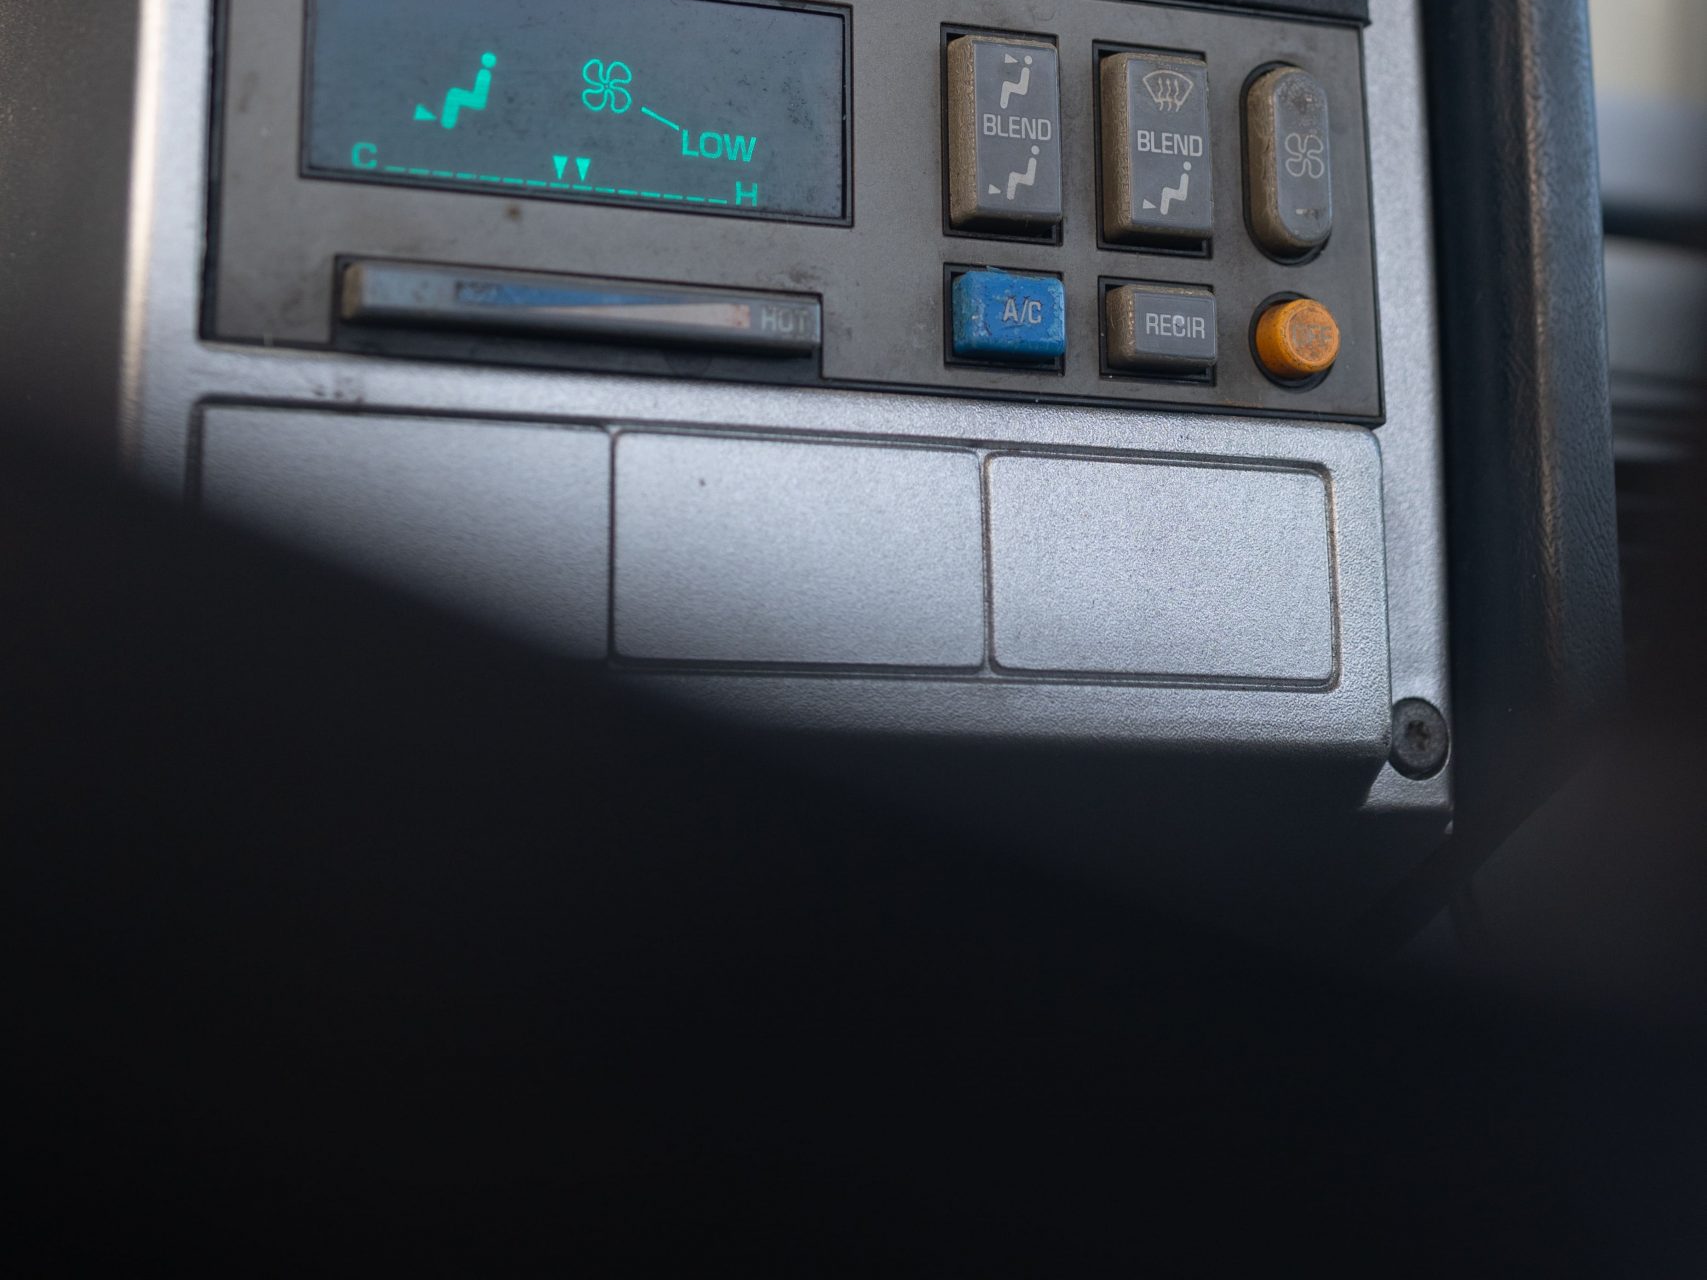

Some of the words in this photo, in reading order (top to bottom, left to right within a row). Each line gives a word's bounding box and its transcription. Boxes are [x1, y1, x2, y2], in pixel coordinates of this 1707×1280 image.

[982, 114, 1053, 141] BLEND
[351, 142, 378, 169] C
[681, 128, 757, 163] LOW
[1136, 130, 1203, 157] BLEND
[735, 181, 758, 206] H
[1002, 297, 1043, 325] A/C
[1145, 312, 1206, 340] RECIR
